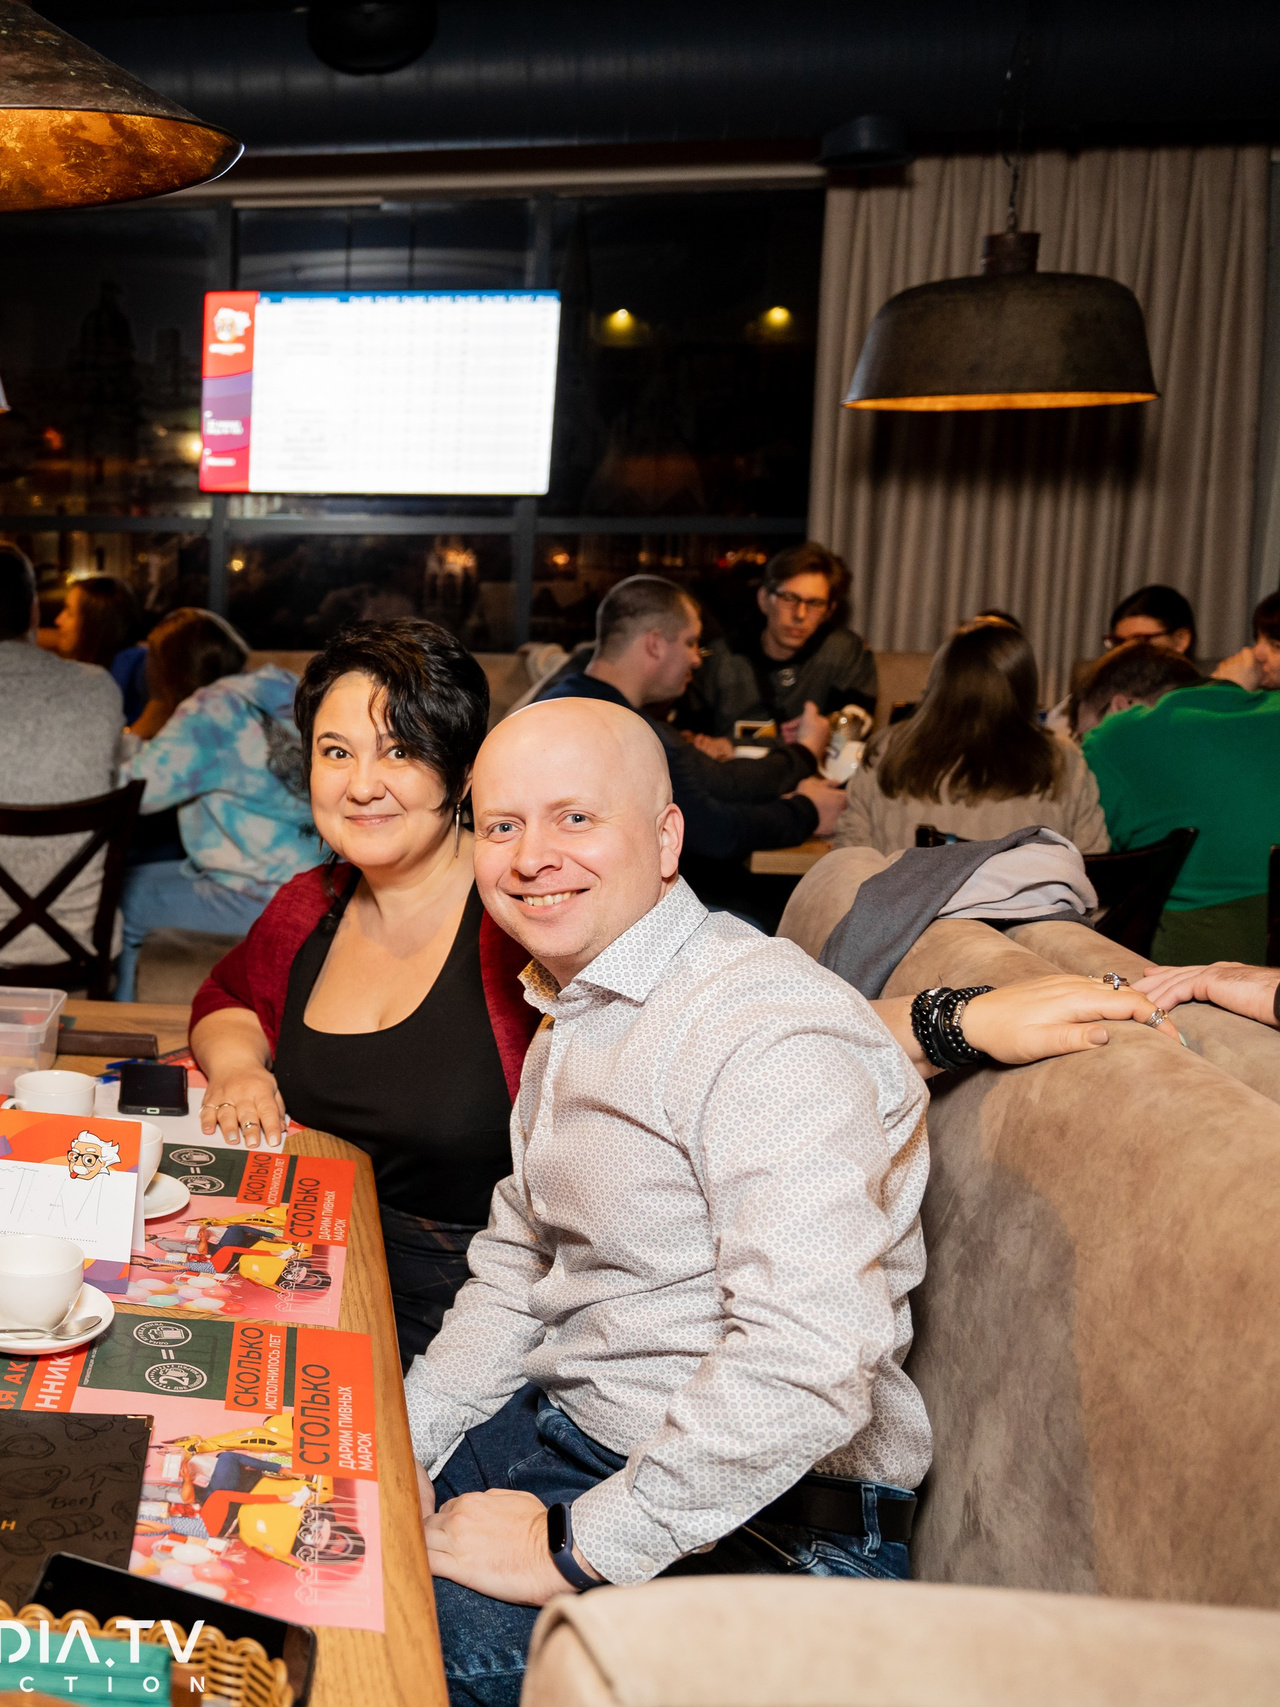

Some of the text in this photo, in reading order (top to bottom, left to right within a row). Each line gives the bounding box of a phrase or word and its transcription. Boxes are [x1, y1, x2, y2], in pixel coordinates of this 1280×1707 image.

[243, 1154, 272, 1202] СКОЛЬКО
[289, 1177, 321, 1238] СТОЛЬКО
[318, 1190, 336, 1240] ДАРИМ ПИВНЫХ
[333, 1218, 346, 1242] МАРОК
[34, 1353, 74, 1410] ННИК
[233, 1327, 264, 1407] СКОЛЬКО
[265, 1333, 281, 1410] ИСПОЛНИЛОСЬ ЛЕТ
[299, 1364, 331, 1465] СТОЛЬКО
[338, 1385, 357, 1470] ДАРИМ ПИВНЫХ
[357, 1431, 373, 1472] МАРОК
